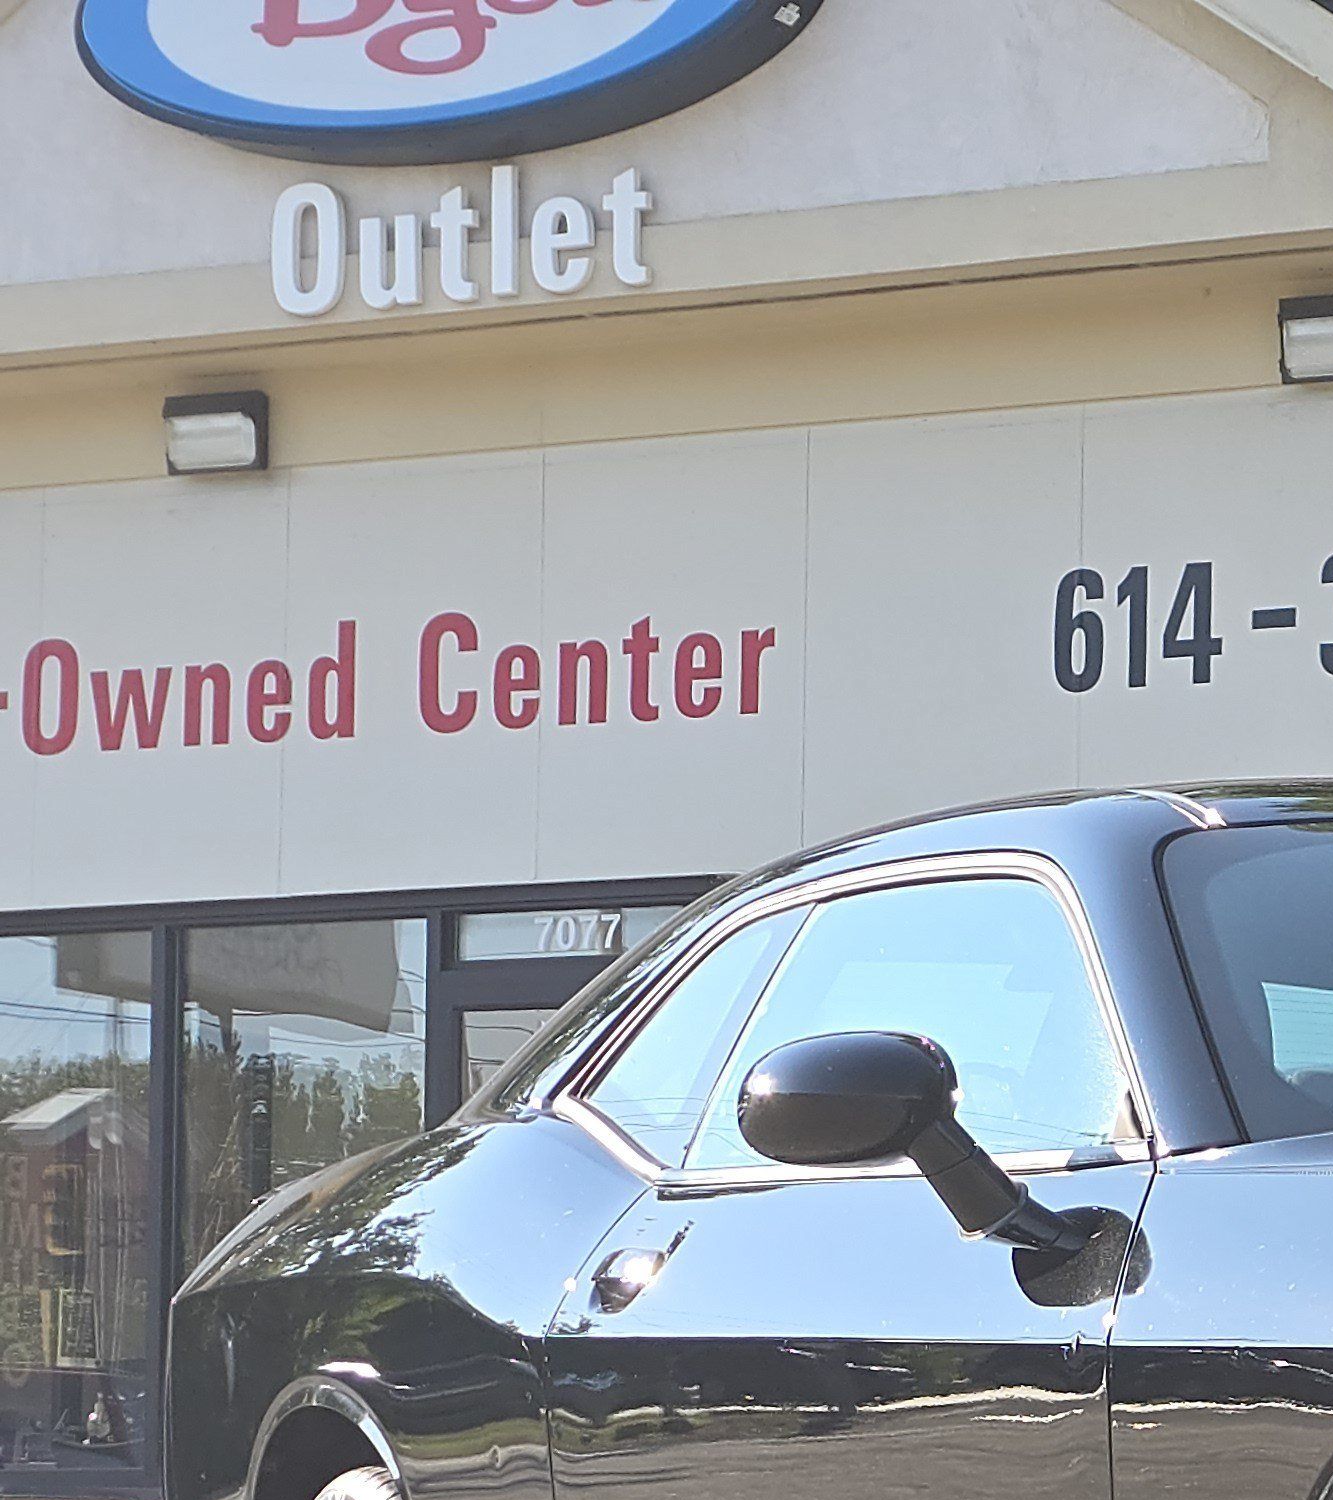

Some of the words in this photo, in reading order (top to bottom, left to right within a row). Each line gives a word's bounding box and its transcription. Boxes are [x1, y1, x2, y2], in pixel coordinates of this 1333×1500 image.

[270, 164, 654, 317] Outlet
[418, 613, 776, 735] Center
[534, 913, 621, 951] 7077
